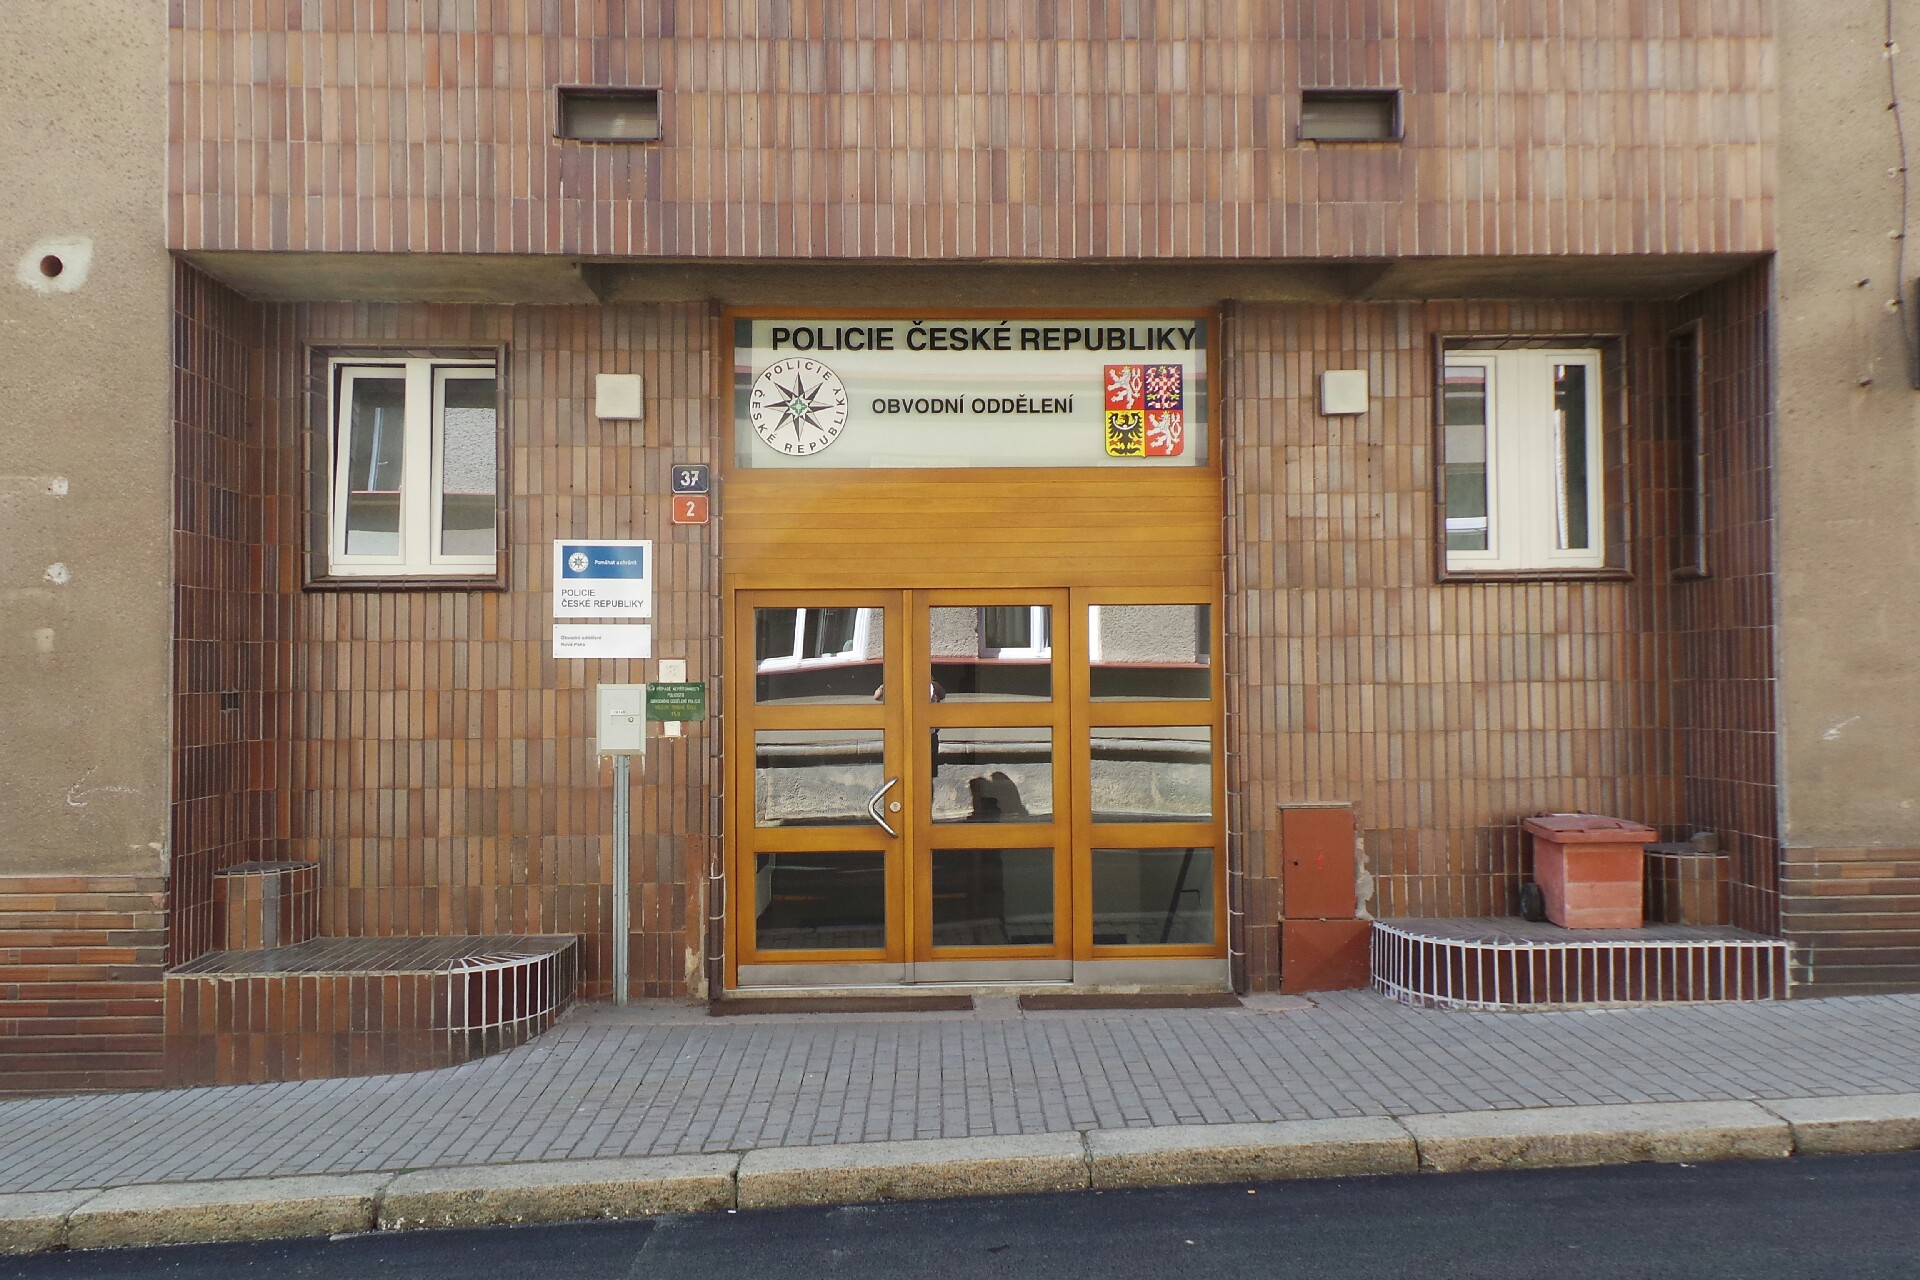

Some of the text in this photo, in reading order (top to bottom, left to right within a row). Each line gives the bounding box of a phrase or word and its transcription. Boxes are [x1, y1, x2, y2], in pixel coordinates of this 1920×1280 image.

[772, 320, 1196, 351] POLICIE ČESKÉ REPUBLIKY
[764, 360, 833, 381] POLICIE
[872, 394, 1074, 414] OBVODNÍ ODDĚLENÍ
[752, 387, 846, 454] ČESKÉ REPUBLIKY
[680, 470, 699, 486] 37
[686, 501, 695, 517] 2
[561, 598, 590, 607] ČESKÉ
